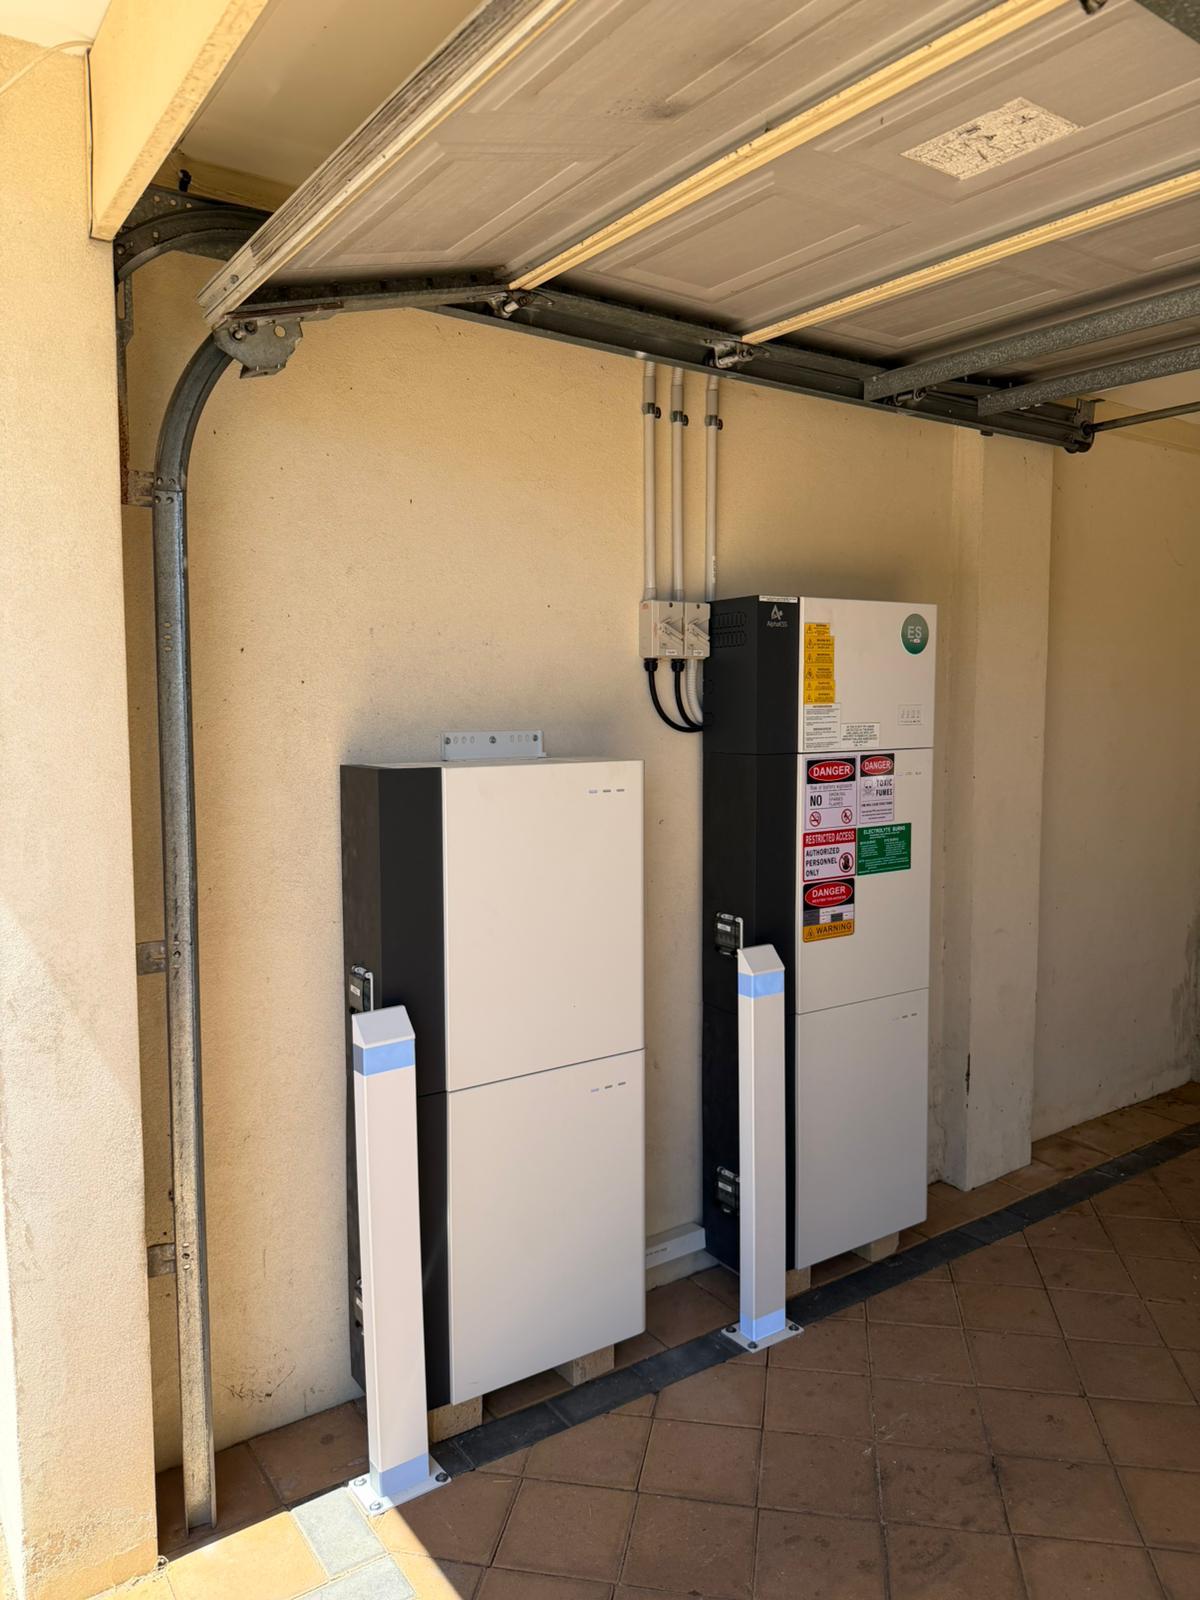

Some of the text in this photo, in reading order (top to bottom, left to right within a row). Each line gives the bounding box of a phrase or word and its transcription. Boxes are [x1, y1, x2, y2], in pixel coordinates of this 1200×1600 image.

[907, 625, 922, 639] ES
[864, 760, 891, 770] DANGER
[813, 765, 850, 777] DANGER
[876, 779, 893, 787] TOXIC
[876, 788, 893, 797] FUMES
[811, 795, 822, 806] NO
[805, 832, 835, 845] RESTRICTED
[835, 831, 855, 842] ACCESS
[806, 847, 840, 857] AUTHORIZED
[806, 857, 838, 866] PERSONNEL
[806, 869, 819, 877] ONLY
[812, 886, 846, 897] DANGER
[816, 922, 852, 935] WARNING
